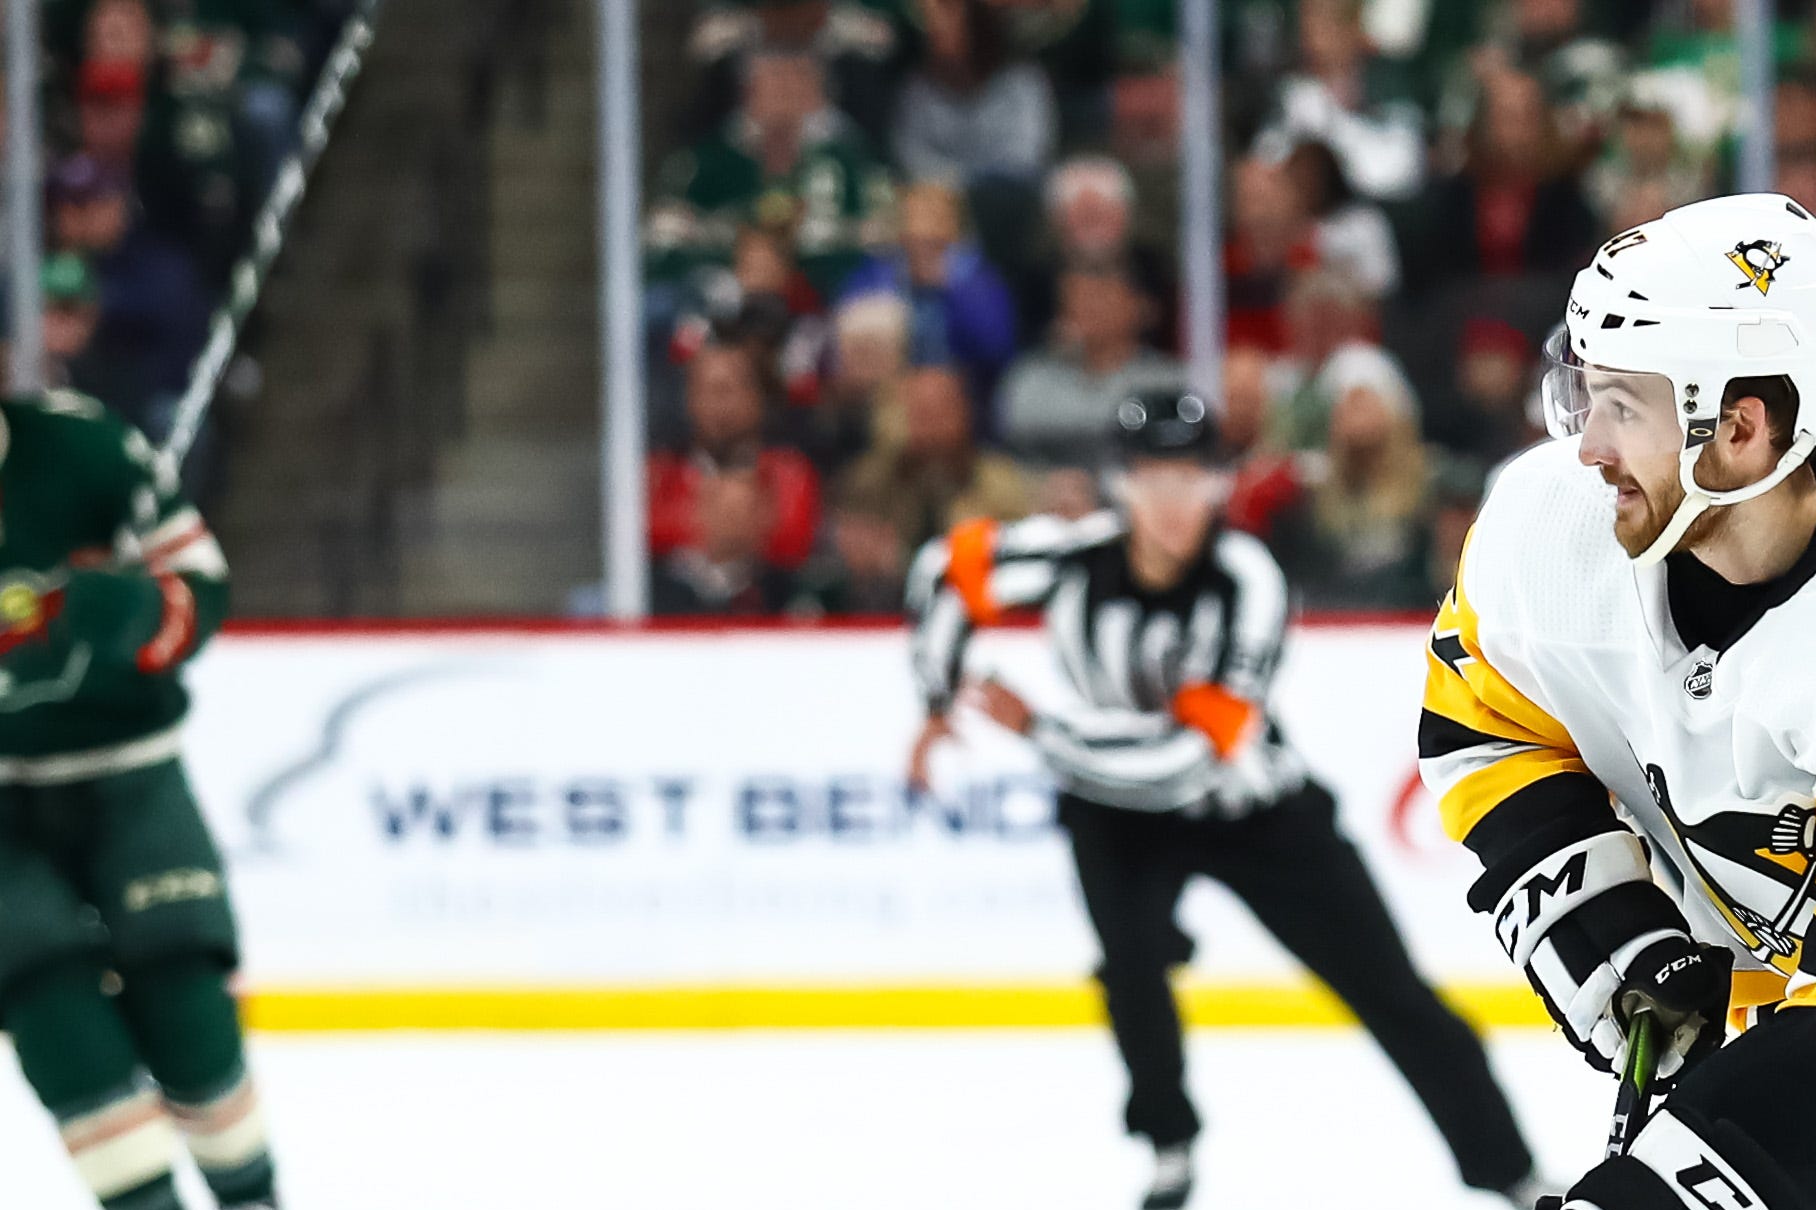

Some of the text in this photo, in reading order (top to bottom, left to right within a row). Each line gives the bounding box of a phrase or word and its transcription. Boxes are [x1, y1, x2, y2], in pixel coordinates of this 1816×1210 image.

[372, 774, 1056, 849] WEST BEND
[1654, 954, 1702, 984] CCM
